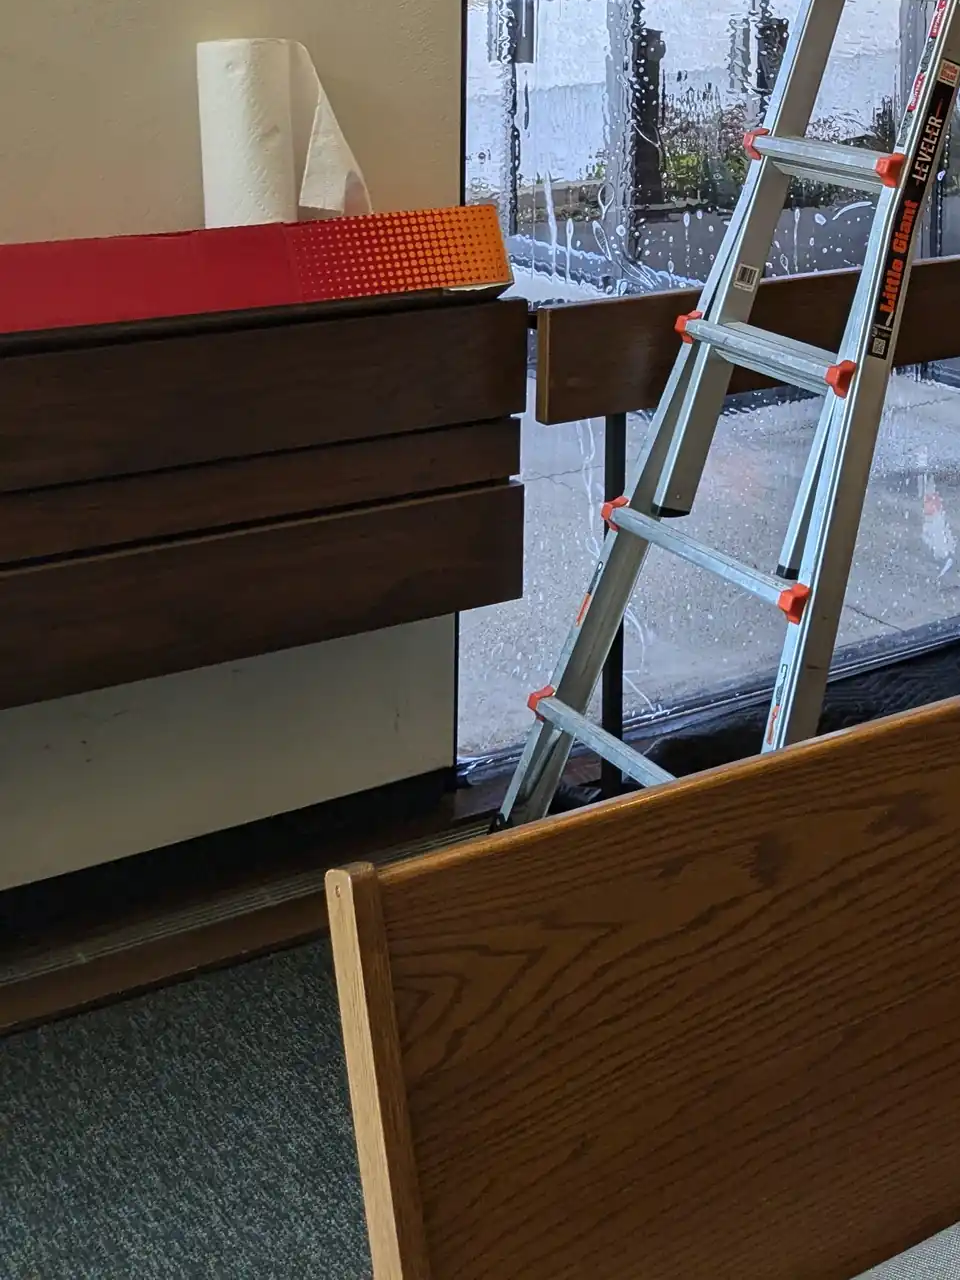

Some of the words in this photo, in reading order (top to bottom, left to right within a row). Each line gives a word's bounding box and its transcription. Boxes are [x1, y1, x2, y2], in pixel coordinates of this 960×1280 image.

[911, 115, 943, 182] LEVELER
[880, 258, 904, 313] Little
[892, 199, 920, 254] Giant
